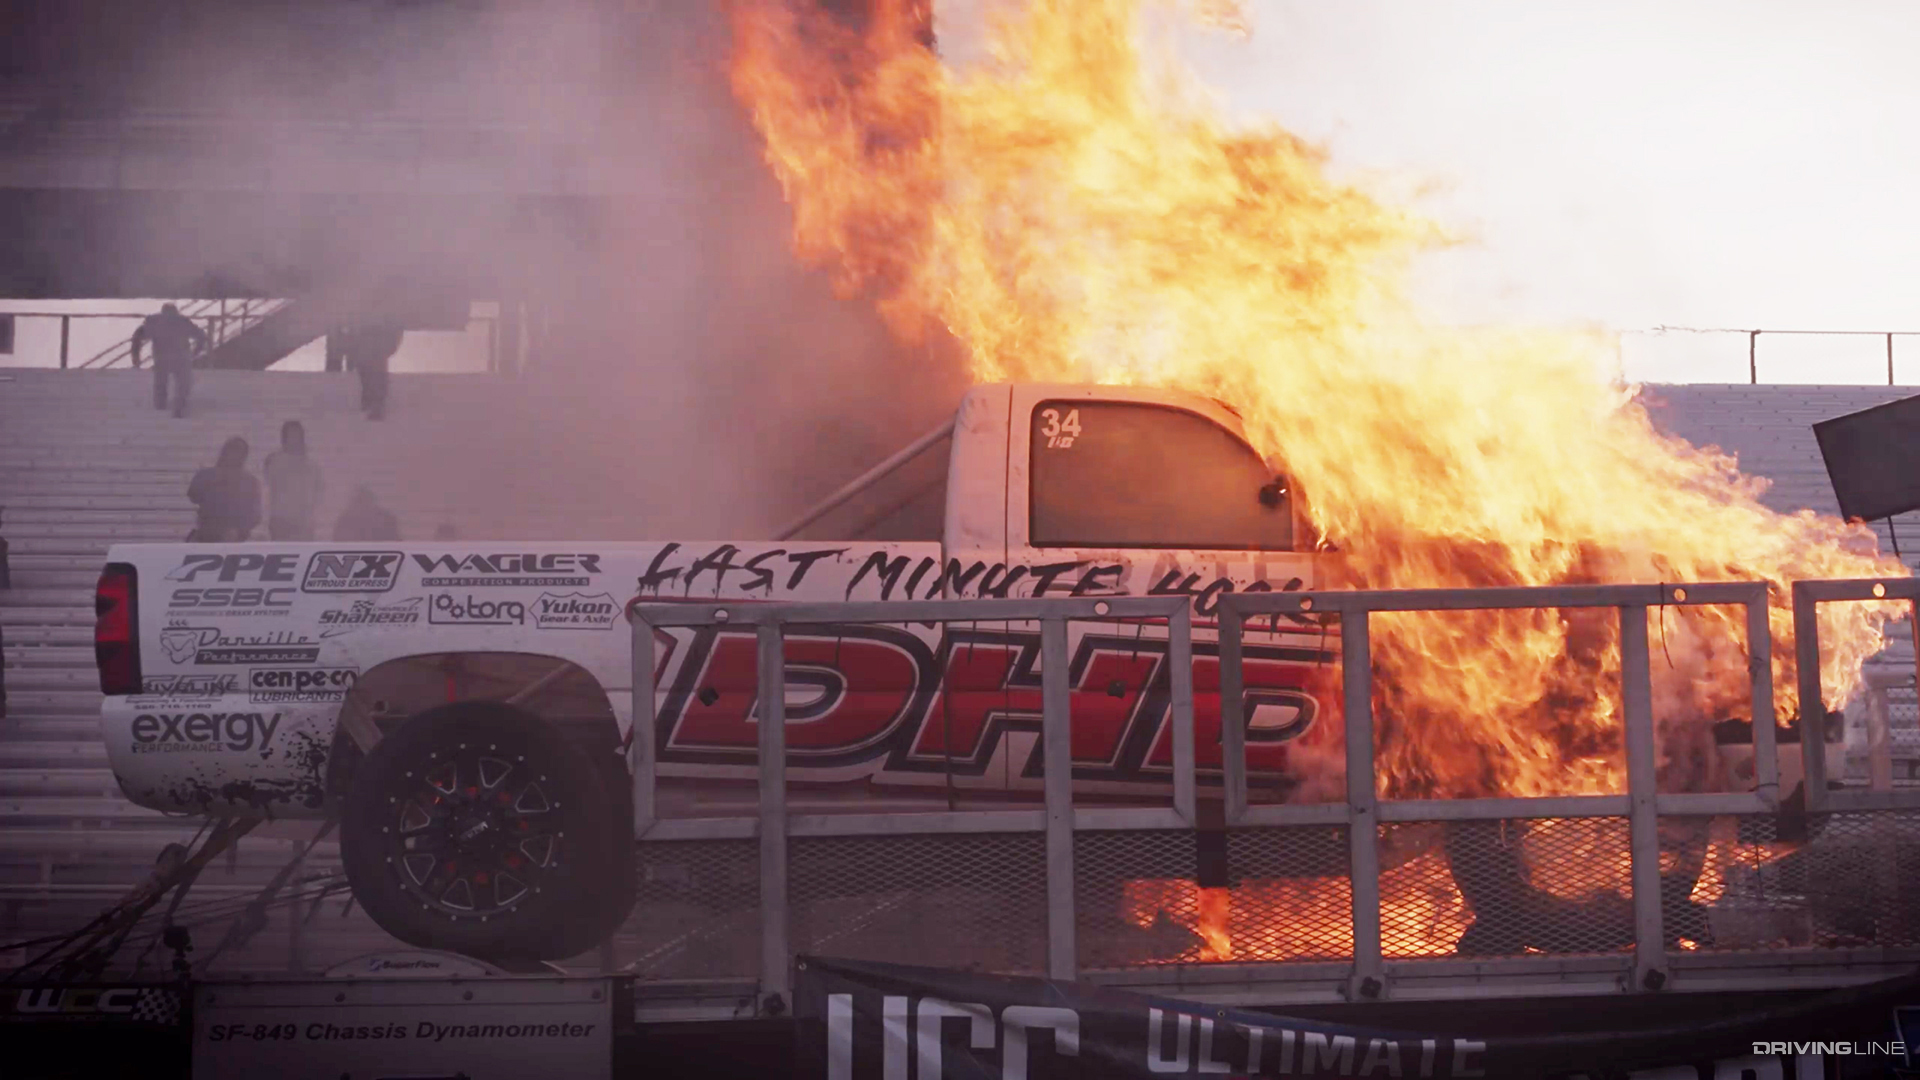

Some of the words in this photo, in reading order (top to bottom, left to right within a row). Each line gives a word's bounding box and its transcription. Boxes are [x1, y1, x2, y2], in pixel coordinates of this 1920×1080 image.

[1041, 408, 1082, 437] 34
[168, 553, 300, 582] PPE
[311, 554, 400, 579] NX
[411, 553, 602, 574] WAGLER
[637, 542, 852, 593] LAST
[845, 550, 1130, 600] MINUTE
[306, 579, 347, 588] NITROUS
[349, 578, 390, 588] EXPRESS
[423, 577, 513, 586] COMPETITION
[519, 577, 590, 586] PRODUCTS
[168, 587, 297, 608] SSBC
[541, 598, 613, 615] Yukon
[318, 606, 420, 625] Shaheen
[539, 614, 569, 623] Gear
[571, 615, 580, 623] &
[582, 614, 611, 623] Axle
[197, 626, 319, 647] Danville
[202, 651, 316, 663] Performance
[253, 691, 343, 701] LUBRICANTS
[131, 712, 283, 751] exergy
[131, 742, 224, 753] PERFORMANCE
[208, 1023, 297, 1041] SF-849
[305, 1022, 407, 1041] Chassis
[415, 1021, 596, 1041] Dynamometer
